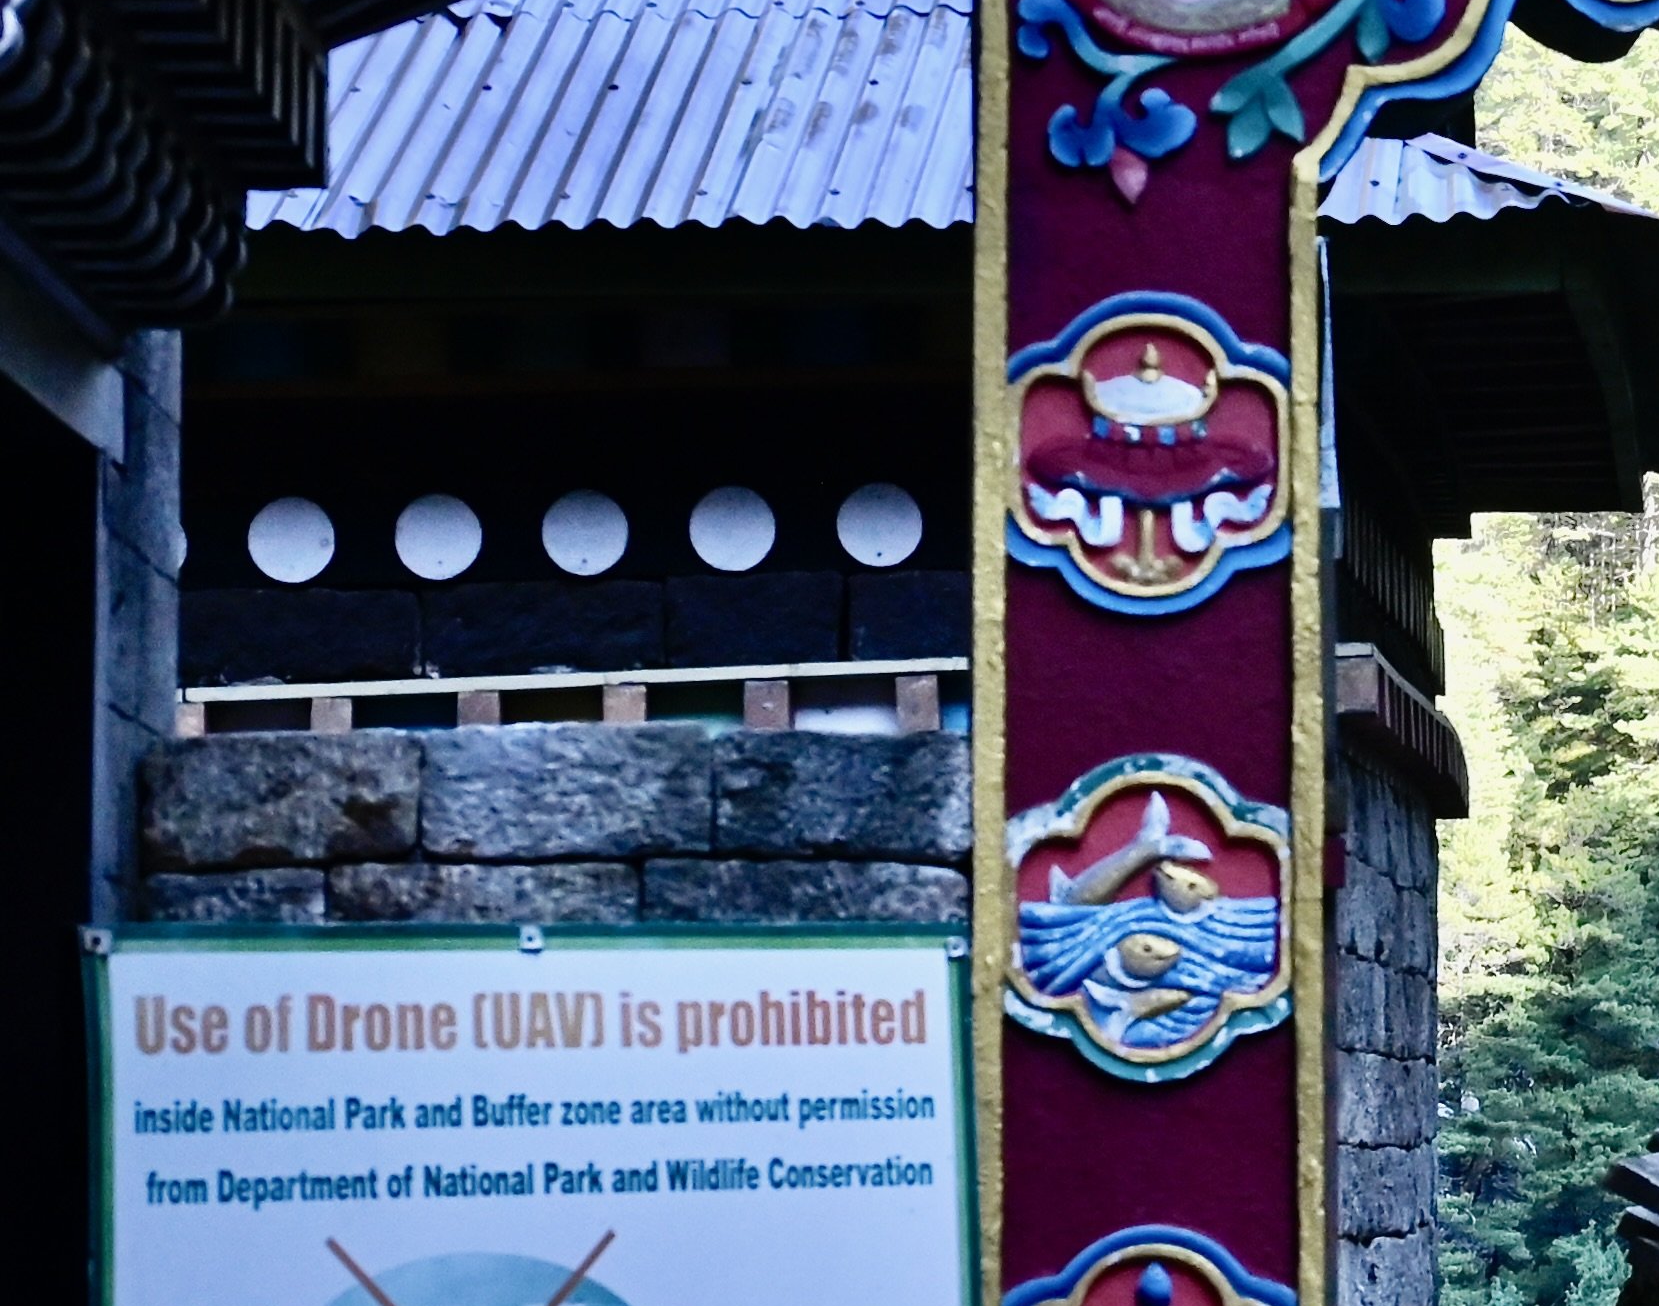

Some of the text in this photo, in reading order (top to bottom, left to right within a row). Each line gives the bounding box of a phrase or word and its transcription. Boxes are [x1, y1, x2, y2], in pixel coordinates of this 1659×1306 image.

[135, 994, 229, 1055] Use
[245, 994, 291, 1053] of
[307, 993, 457, 1052] Drone
[619, 991, 662, 1048] is
[677, 990, 926, 1054] prohibited
[134, 1089, 935, 1134] inside National Park and Buffer zone area without permission
[146, 1155, 933, 1211] from Department of National Park and Wildlife Conservation
